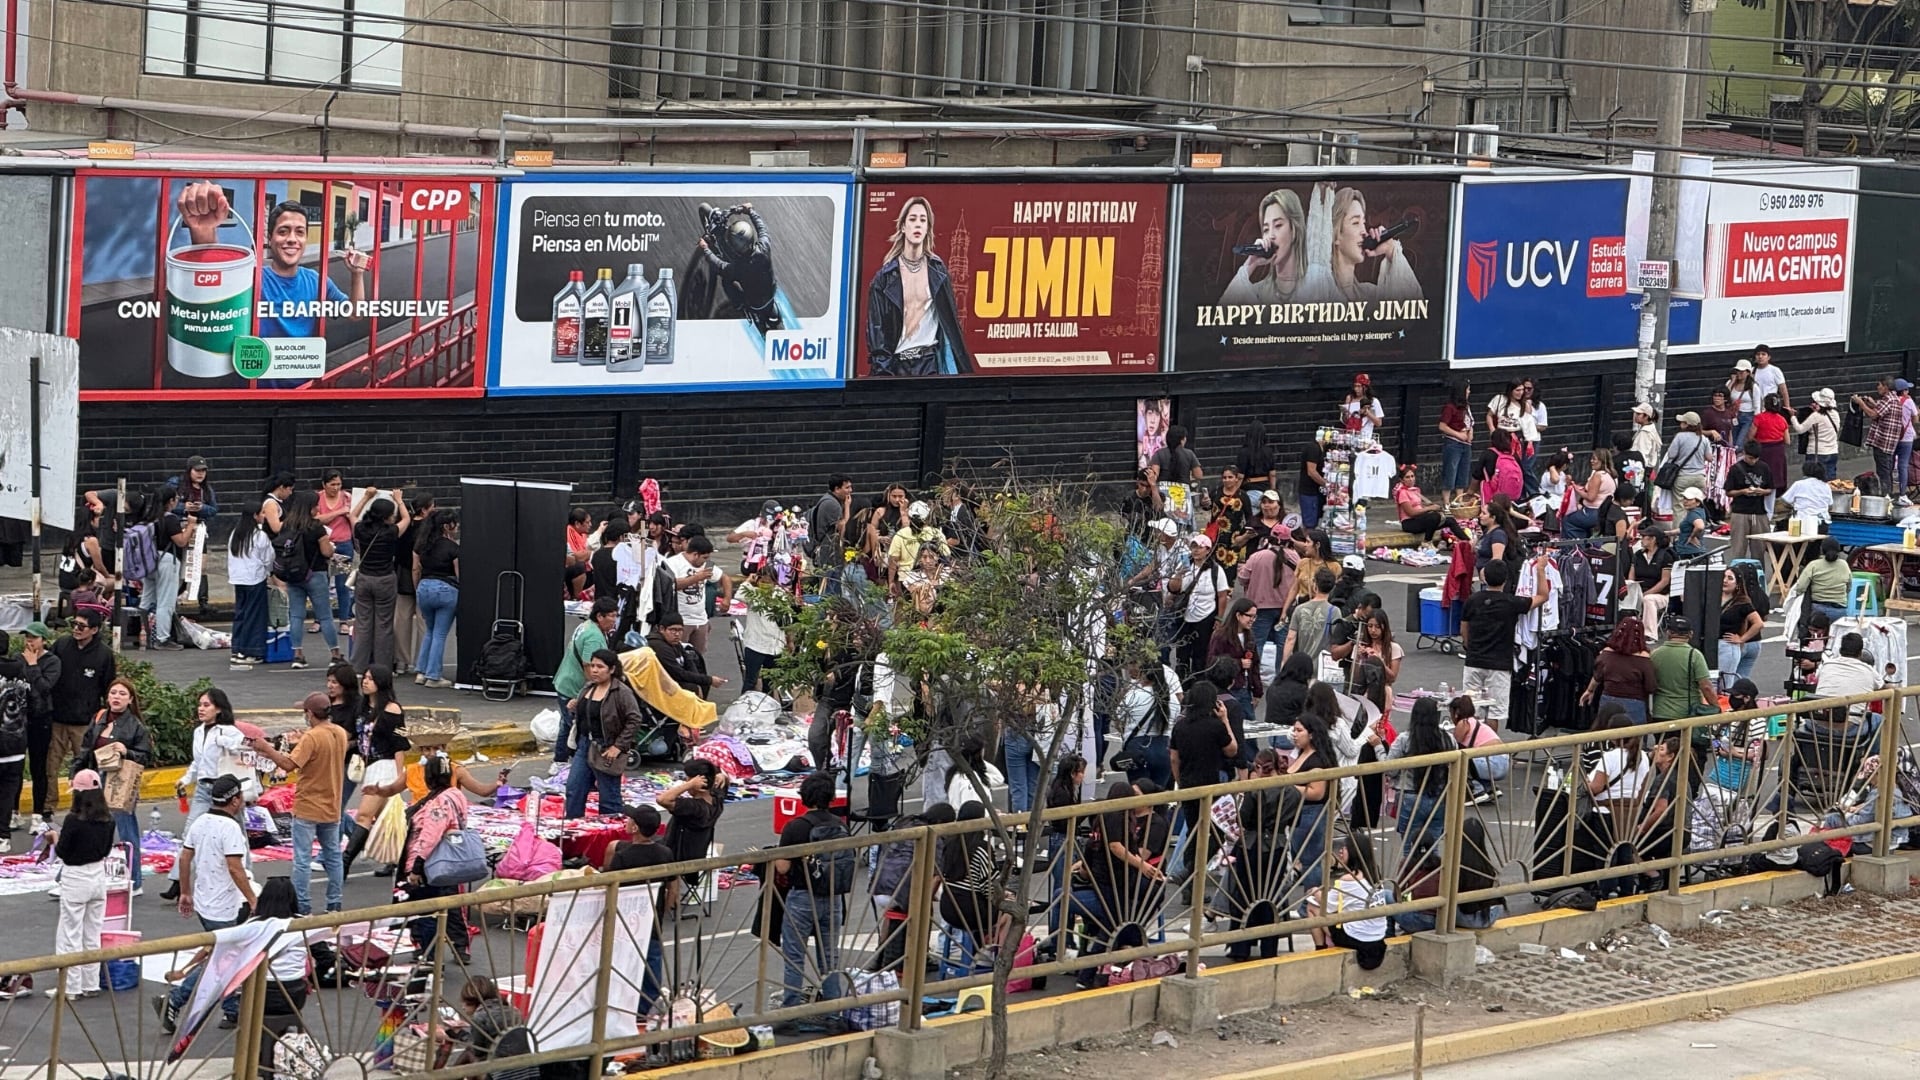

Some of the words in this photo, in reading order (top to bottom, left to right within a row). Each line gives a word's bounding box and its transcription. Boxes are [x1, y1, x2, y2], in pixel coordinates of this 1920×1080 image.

[411, 189, 461, 211] CPP
[1770, 195, 1787, 210] 950
[1789, 194, 1806, 209] 289
[1807, 193, 1824, 208] 976
[534, 210, 580, 227] Piensa
[583, 215, 601, 227] en
[604, 211, 619, 227] tu
[623, 211, 666, 227] moto.
[1013, 201, 1063, 223] HAPPY
[1067, 201, 1137, 223] BIRTHDAY
[532, 235, 581, 252] Piensa
[584, 239, 603, 252] en
[1592, 242, 1626, 257] Estudia
[1743, 231, 1785, 253] Nuevo
[1787, 232, 1838, 254] campus
[1506, 239, 1580, 288] UCV
[1591, 259, 1612, 273] toda
[1614, 260, 1622, 273] la
[1733, 258, 1775, 284] LIMA
[1778, 253, 1843, 282] CENTRO
[197, 274, 218, 284] CPP
[974, 237, 1115, 318] JIMIN
[1590, 276, 1623, 288] carrera
[118, 301, 161, 318] CON
[170, 304, 200, 320] Metal
[202, 311, 209, 323] y
[210, 306, 249, 320] Madera
[257, 301, 280, 318] EL
[282, 301, 354, 318] BARRIO
[356, 301, 449, 318] RESUELVE
[1196, 303, 1265, 326] HAPPY
[1270, 301, 1370, 325] BIRTHDAY,
[1373, 300, 1429, 321] JIMIN
[1740, 310, 1749, 320] Av.
[1750, 309, 1777, 321] Argentina
[1791, 307, 1814, 317] Cercado
[1814, 307, 1821, 315] de
[1822, 305, 1835, 315] Lima
[184, 324, 212, 333] PINTURA
[212, 324, 234, 333] GLOSS
[987, 323, 1030, 339] AREQUIPA
[1032, 323, 1044, 338] TE
[1044, 322, 1079, 338] SALUDA
[1254, 335, 1286, 344] nuestros
[1286, 335, 1321, 343] corazones
[1321, 333, 1340, 342] hacia
[1341, 333, 1346, 341] ti
[1347, 332, 1359, 342] hoy
[240, 349, 263, 359] PRACTI
[240, 359, 263, 370] TECH
[1596, 572, 1614, 605] 7
